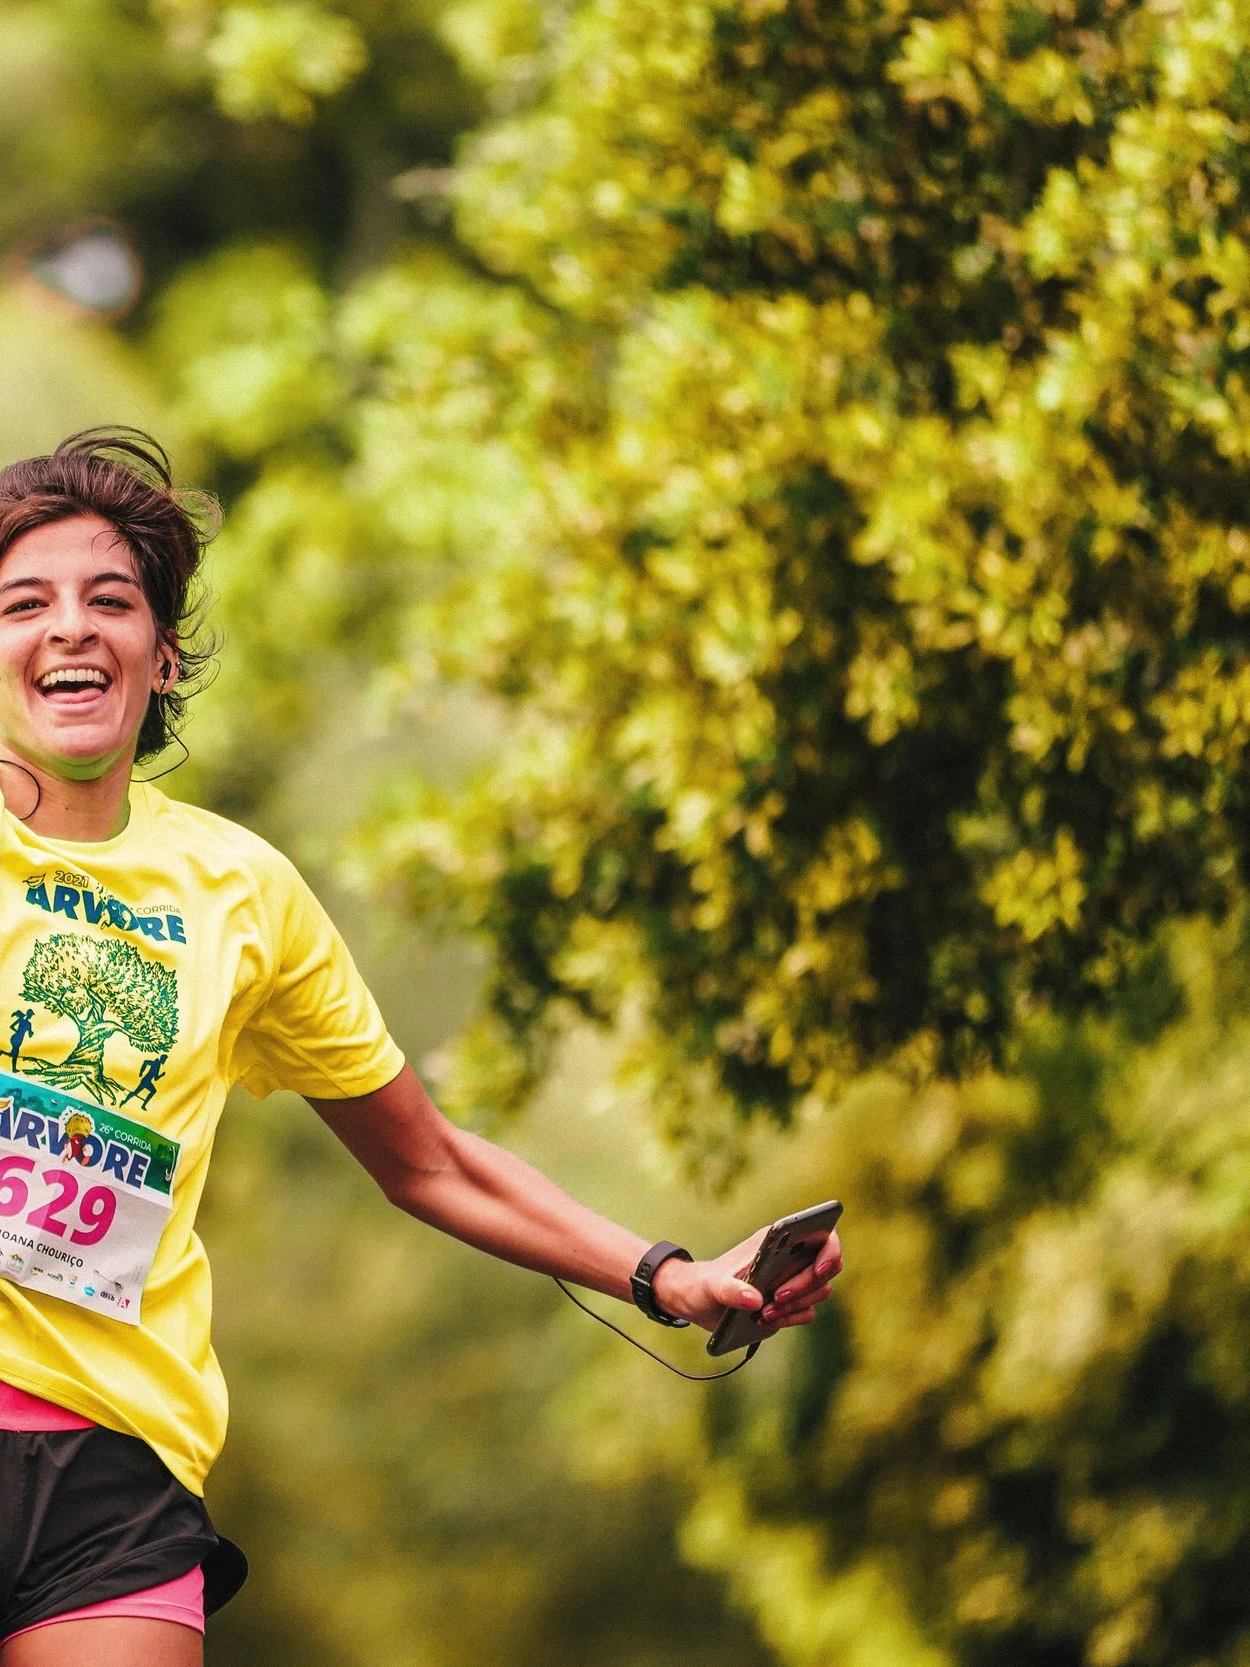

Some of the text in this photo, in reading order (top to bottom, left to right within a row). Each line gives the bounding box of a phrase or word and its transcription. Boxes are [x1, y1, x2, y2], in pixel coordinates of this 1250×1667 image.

[53, 870, 90, 888] 2021
[136, 904, 181, 915] CORRIDA
[114, 1129, 152, 1153] CORRIDA
[36, 1243, 84, 1268] CHOURIÇO
